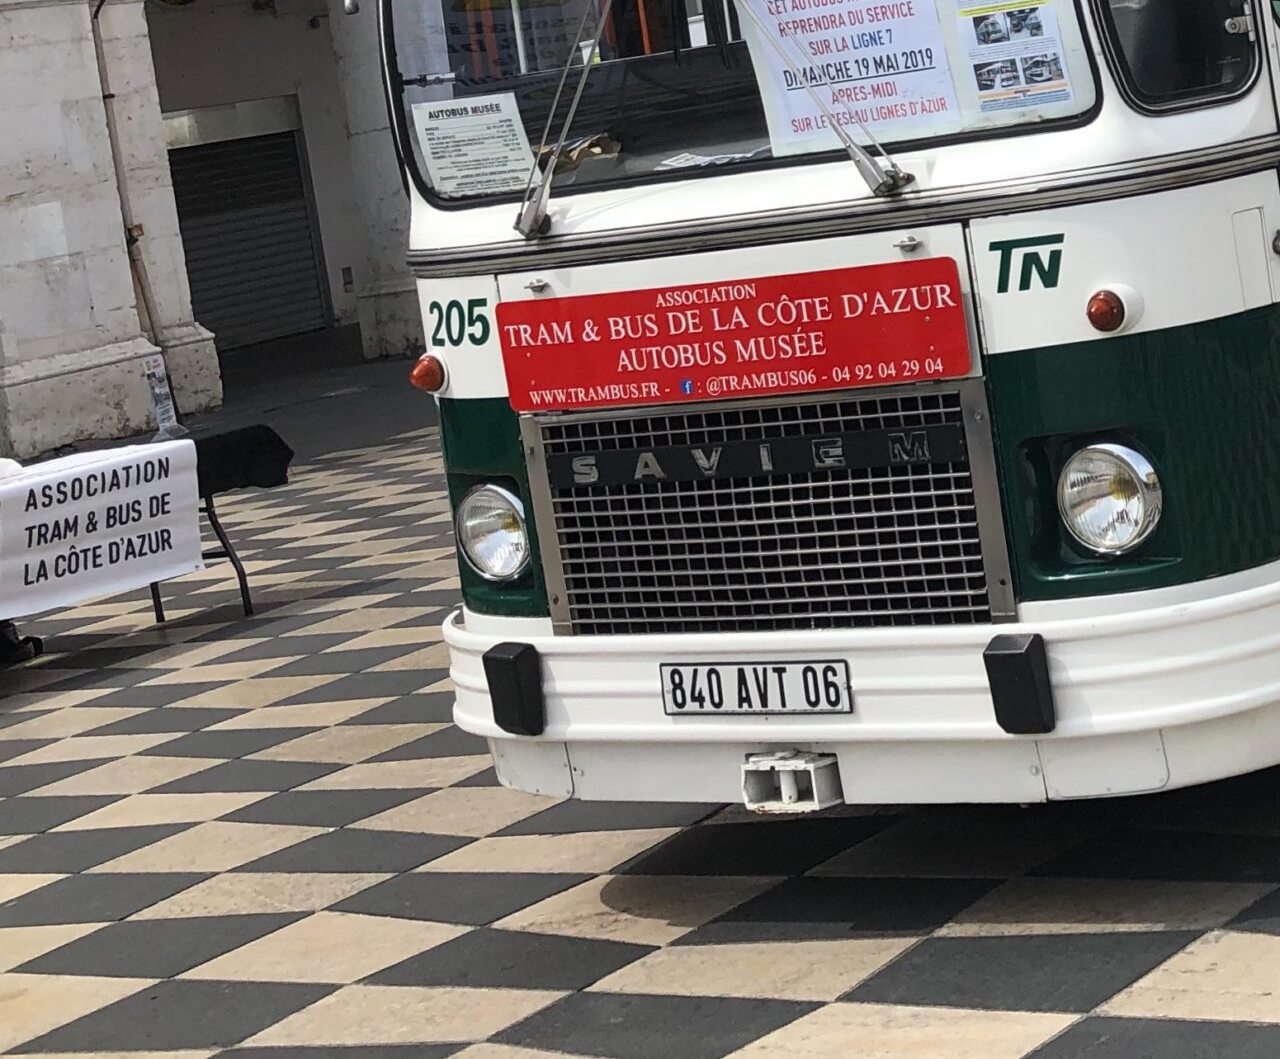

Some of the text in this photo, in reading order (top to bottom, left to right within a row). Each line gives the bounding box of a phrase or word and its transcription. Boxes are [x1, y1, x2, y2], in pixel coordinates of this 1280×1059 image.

[849, 10, 864, 27] DU
[866, 0, 915, 23] SERVICE
[808, 28, 893, 56] SUR LA LIGNE 7
[783, 47, 934, 87] DIMANCHE 19 MAI 2019
[428, 102, 502, 120] AUTOBUS MUSÉE
[791, 116, 812, 133] SUR
[815, 113, 828, 130] LE
[871, 102, 907, 122] LIGNES
[988, 233, 1065, 294] TN
[504, 283, 957, 348] TRAM & BUS DE LA CÔTE D'AZUR
[655, 282, 757, 308] ASSOCIATION
[429, 298, 491, 348] 205
[617, 326, 827, 373] AUTOBUS MUSÉE
[529, 382, 661, 406] WWW.TRAMBUS.FR
[706, 368, 817, 396] @TRAMBUS06
[832, 366, 850, 383] 04
[855, 363, 873, 380] 92
[878, 362, 896, 378] 04
[901, 360, 919, 377] 29
[925, 357, 943, 374] 04
[572, 430, 931, 485] SAVIEM
[24, 456, 170, 512] ASSOCIATION
[25, 493, 171, 549] TRAM & BUS DE
[24, 528, 173, 586] LA CÔTE D'AZUR
[670, 664, 841, 710] 840 AVT 06
